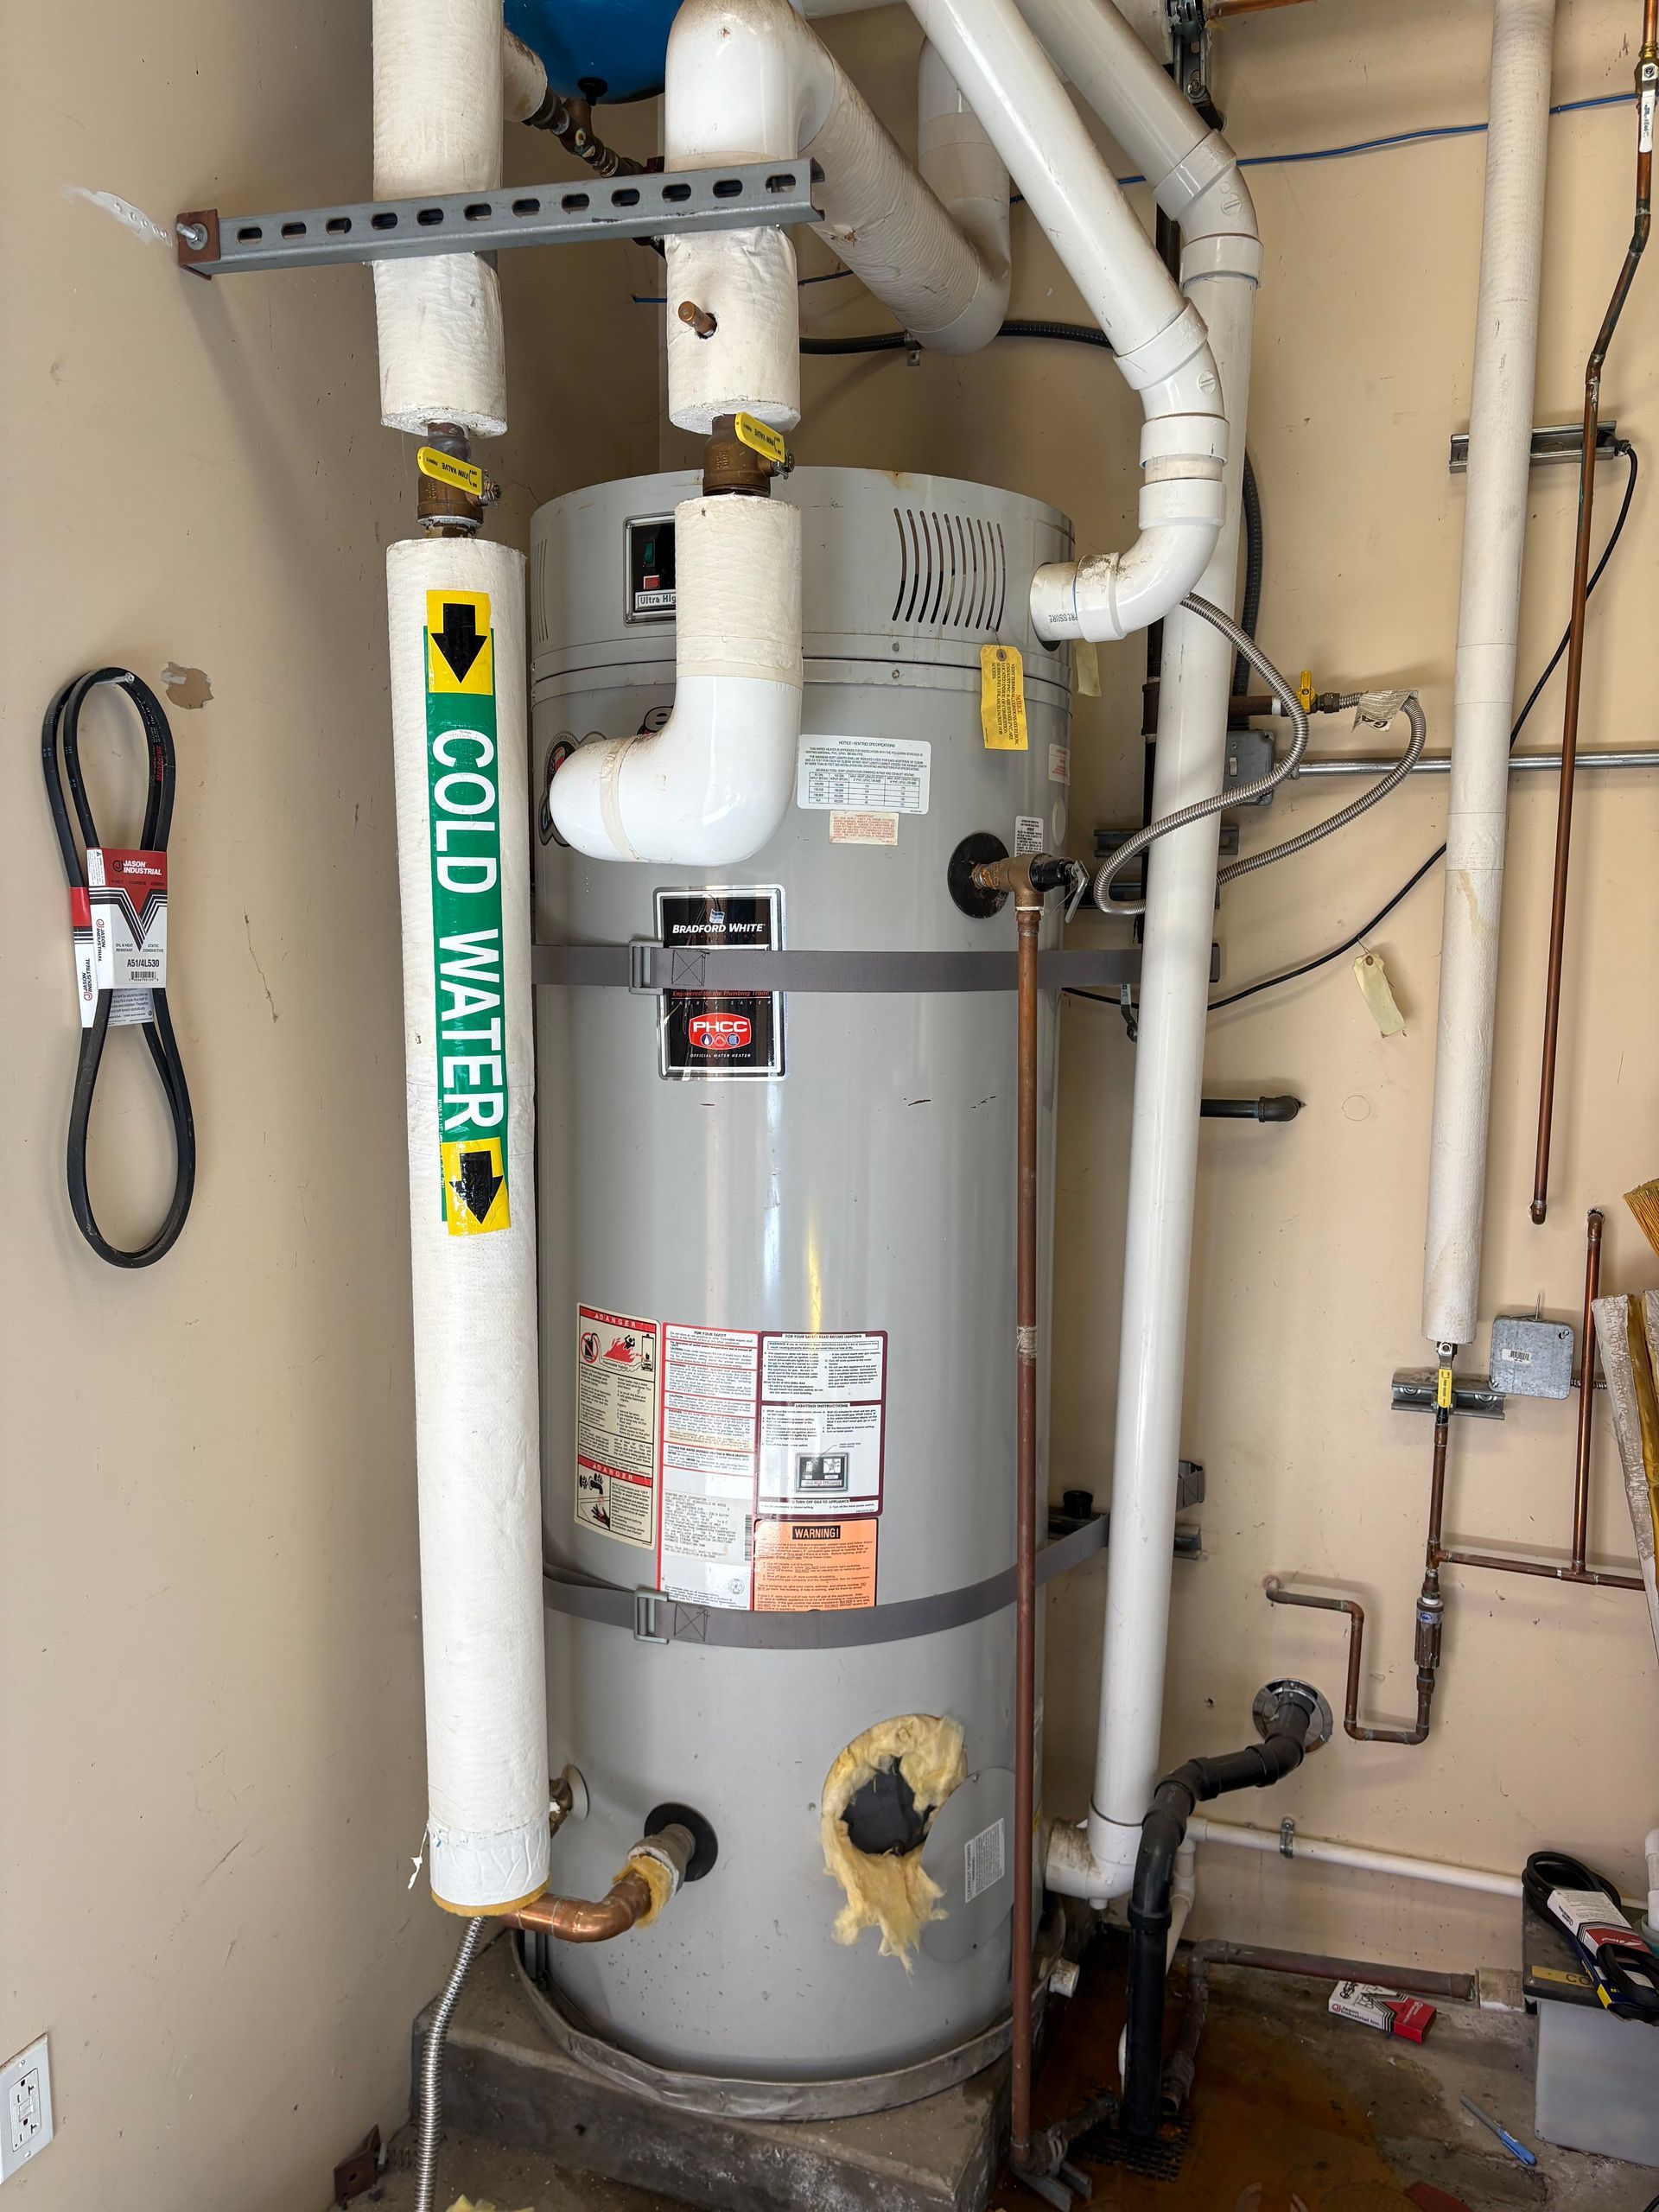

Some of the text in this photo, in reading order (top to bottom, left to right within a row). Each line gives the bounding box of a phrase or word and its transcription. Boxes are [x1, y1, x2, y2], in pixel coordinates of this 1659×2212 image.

[640, 594, 676, 605] Ultra Hig
[1048, 613, 1078, 623] PRESSURE
[124, 868, 162, 876] INDUSTRIAL
[432, 728, 505, 1131] COLD WATER
[672, 924, 764, 934] BRADFORD WHITE
[127, 959, 160, 968] A51/4L530
[693, 1021, 748, 1033] PHCC
[600, 1315, 636, 1328] DANGER
[597, 1465, 633, 1482] DANGER
[795, 1528, 840, 1539] WARNING!
